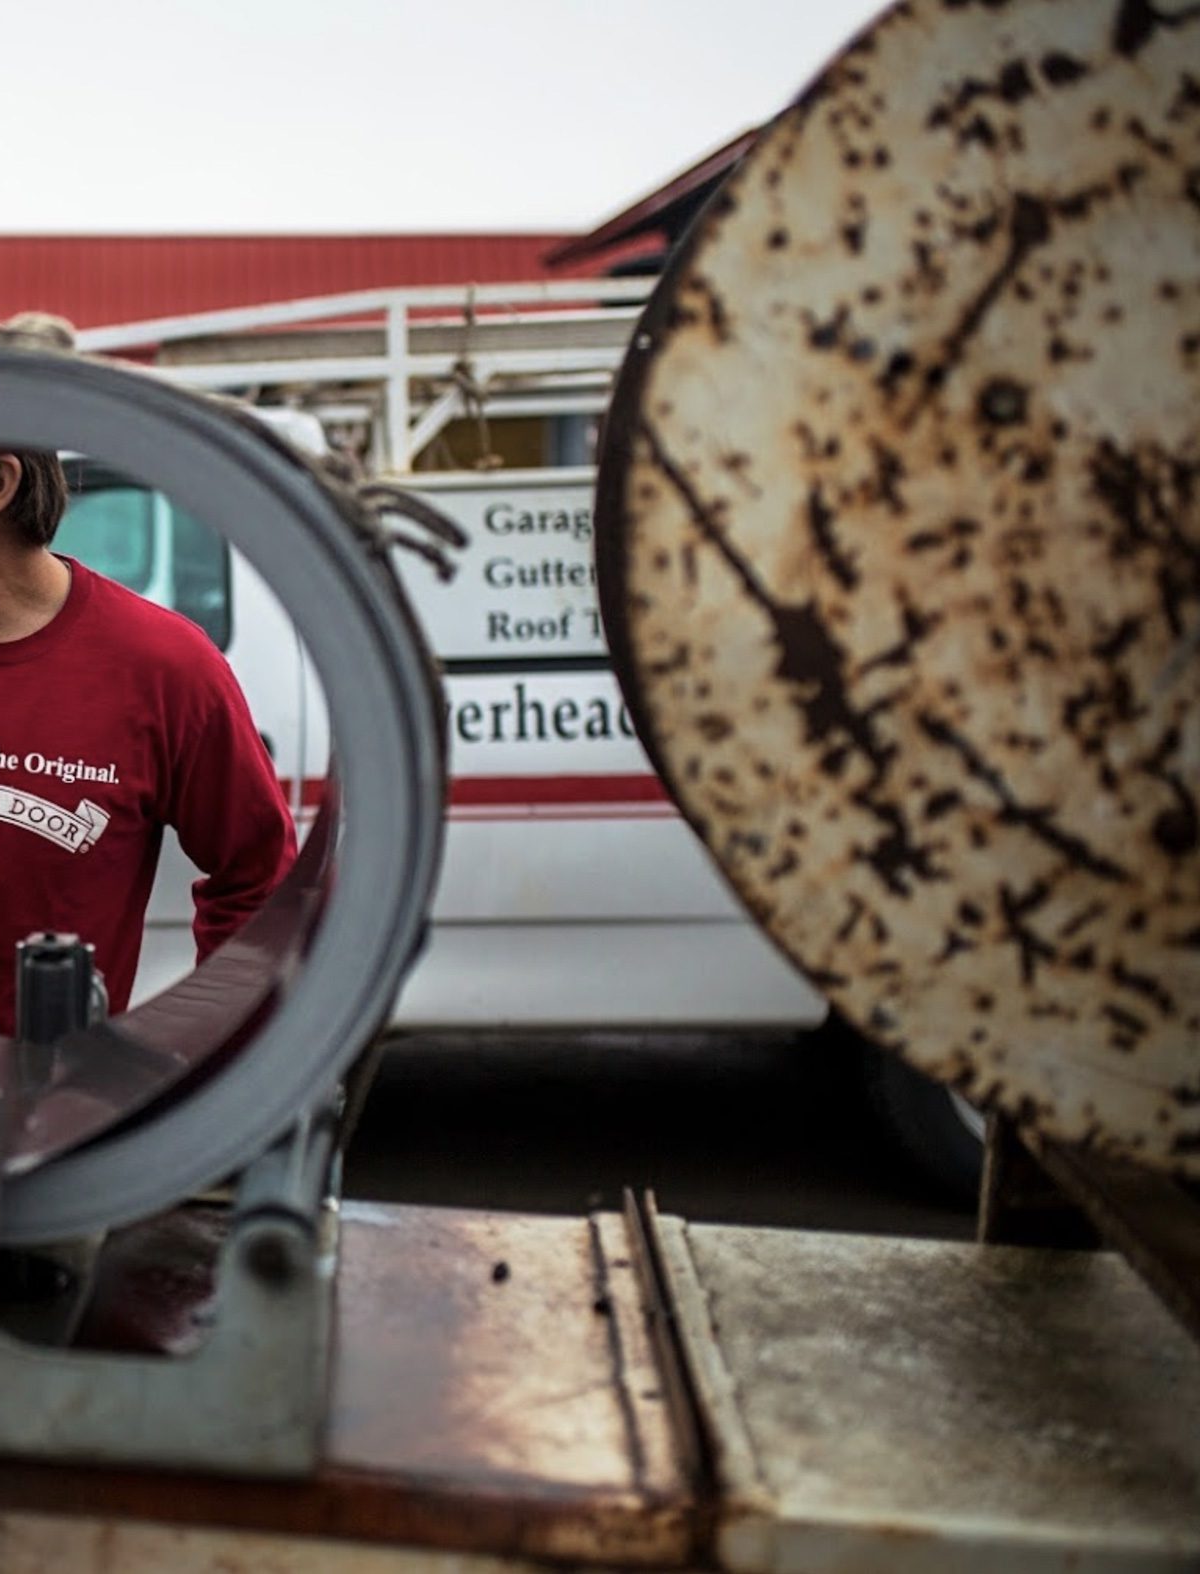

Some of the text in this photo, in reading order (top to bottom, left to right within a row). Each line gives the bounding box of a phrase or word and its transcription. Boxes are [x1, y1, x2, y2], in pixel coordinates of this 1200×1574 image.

[487, 606, 574, 641] Roof
[451, 683, 636, 743] erhea
[24, 753, 120, 784] Original.
[8, 793, 80, 843] DOOR
